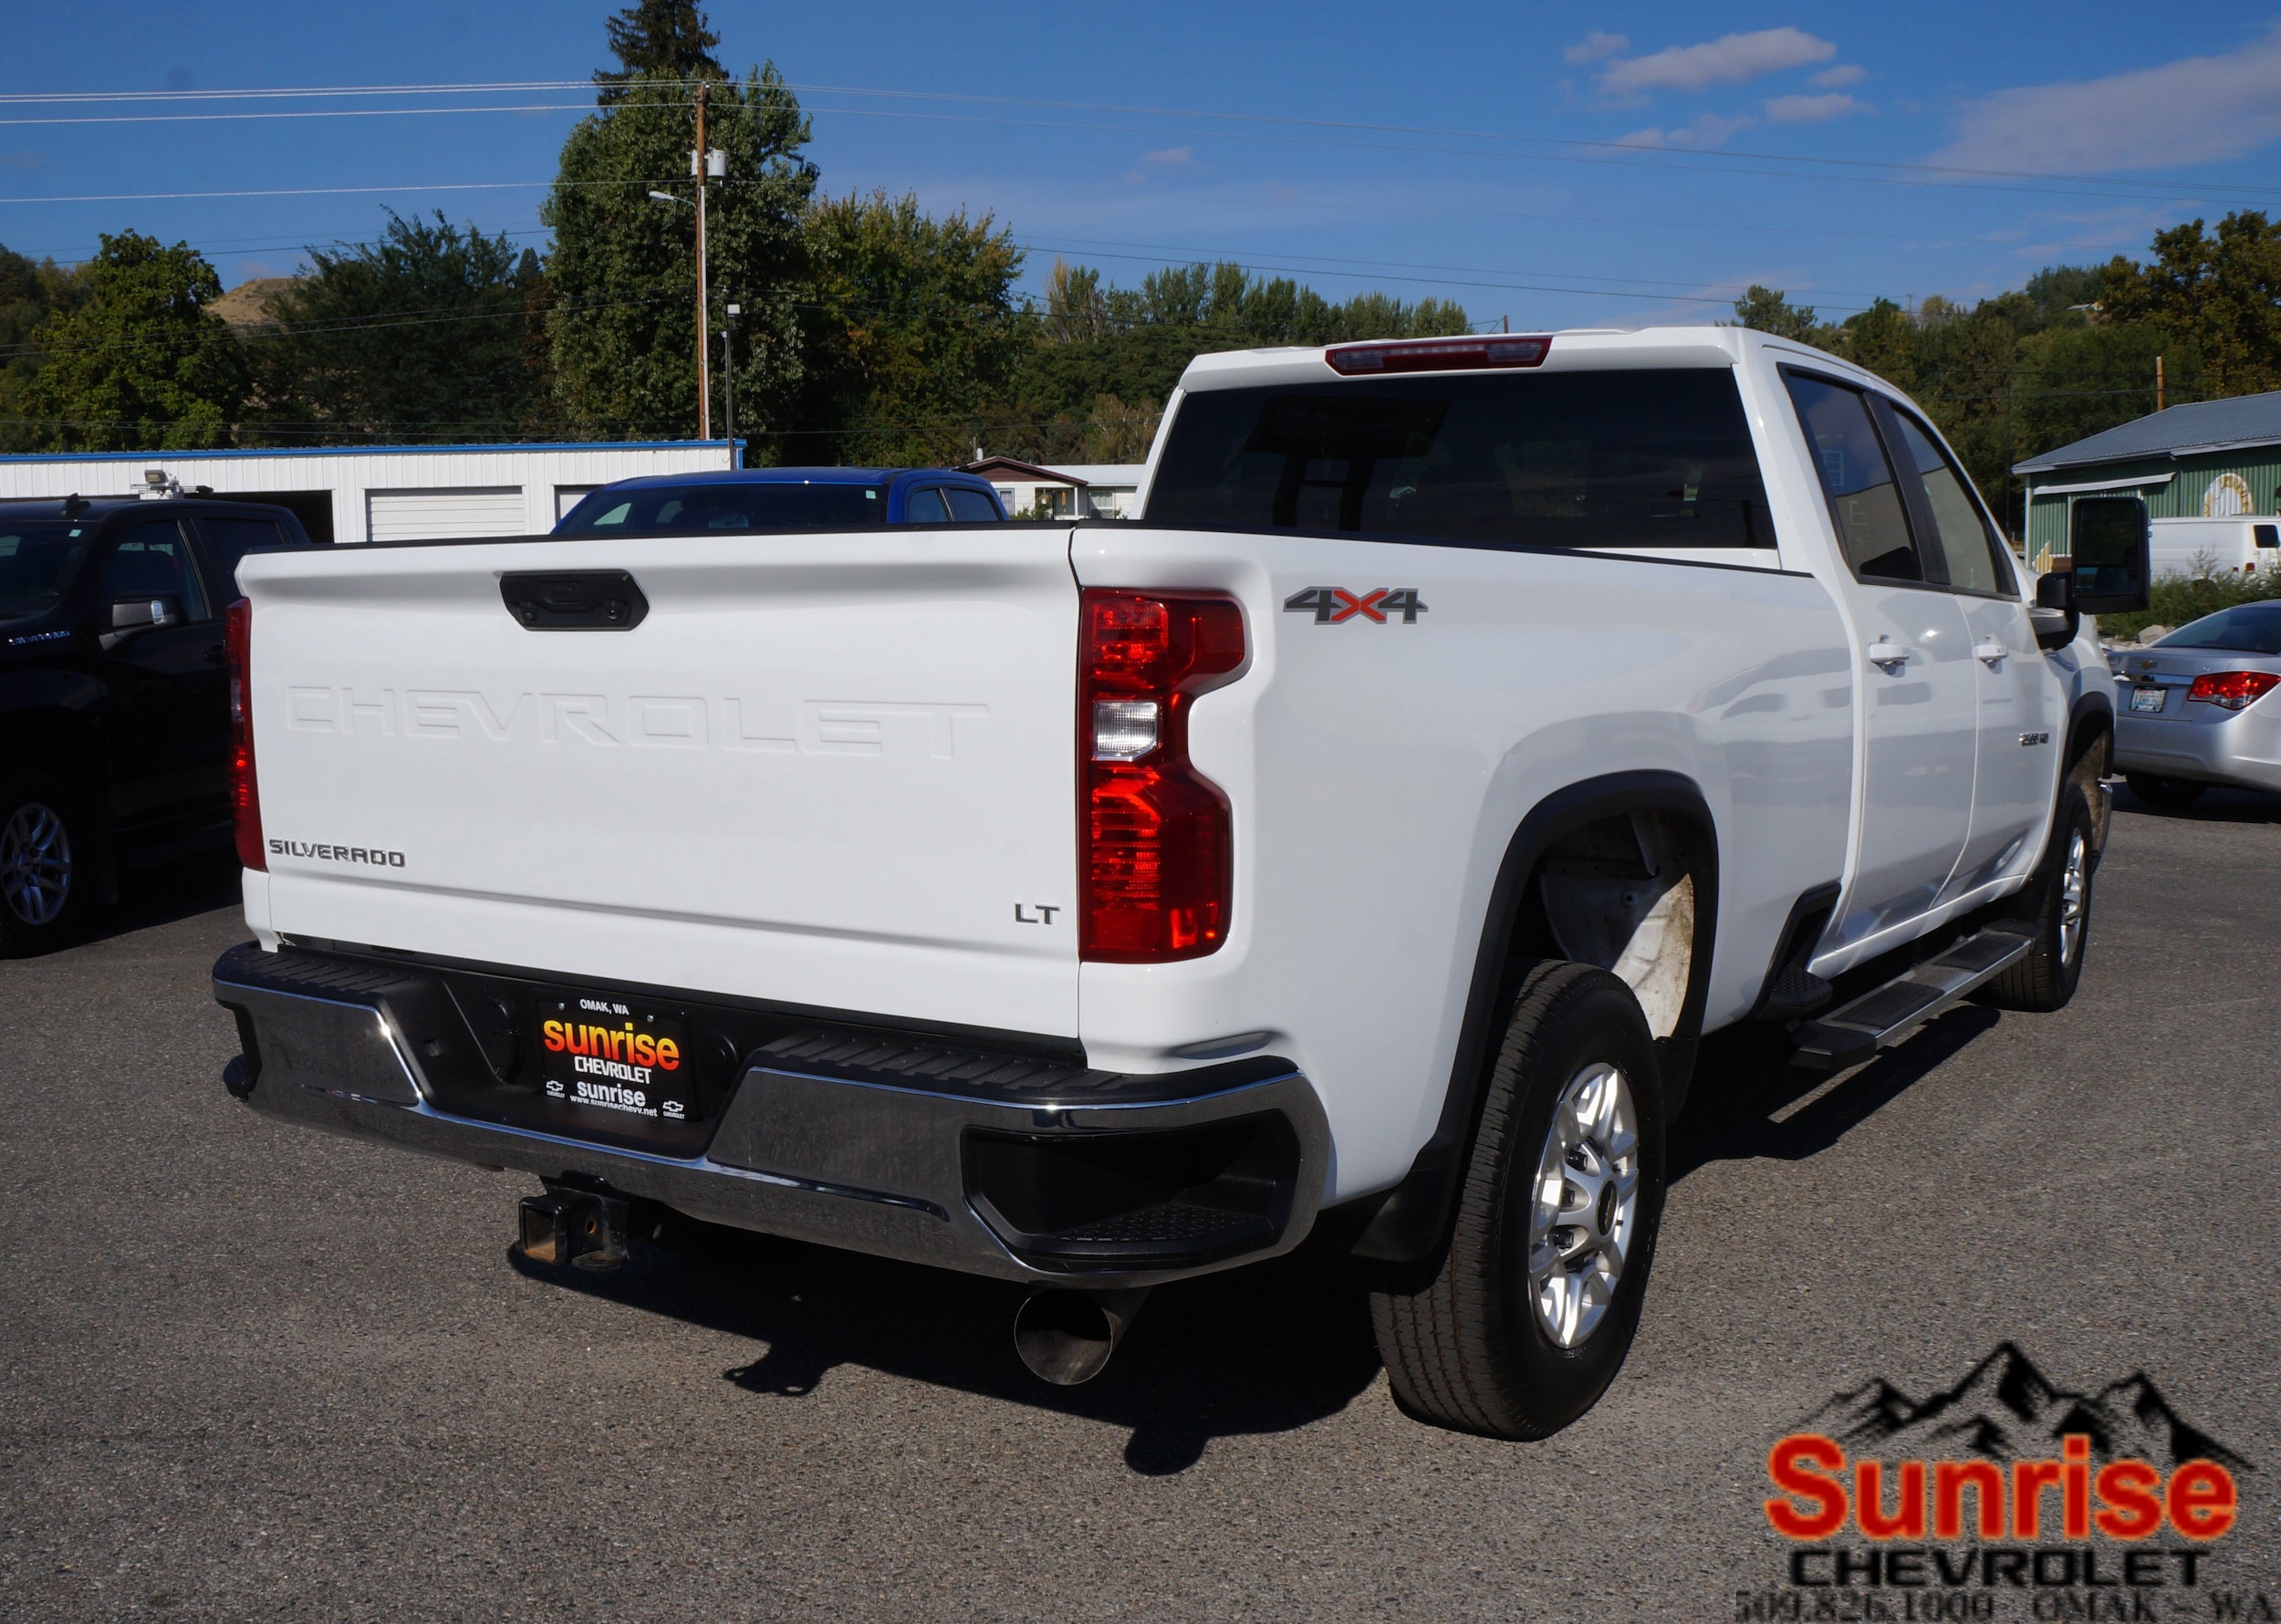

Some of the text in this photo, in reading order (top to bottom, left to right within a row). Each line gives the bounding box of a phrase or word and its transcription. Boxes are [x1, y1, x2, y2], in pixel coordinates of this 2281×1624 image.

[286, 685, 990, 759] CHEVROLET
[269, 839, 406, 868] SILVERADO
[1015, 902, 1061, 925] LT
[579, 998, 630, 1015] OMAK, WA
[543, 1020, 680, 1071] sunrise
[574, 1056, 652, 1084] CHEVROLET
[577, 1081, 647, 1107] sunrise
